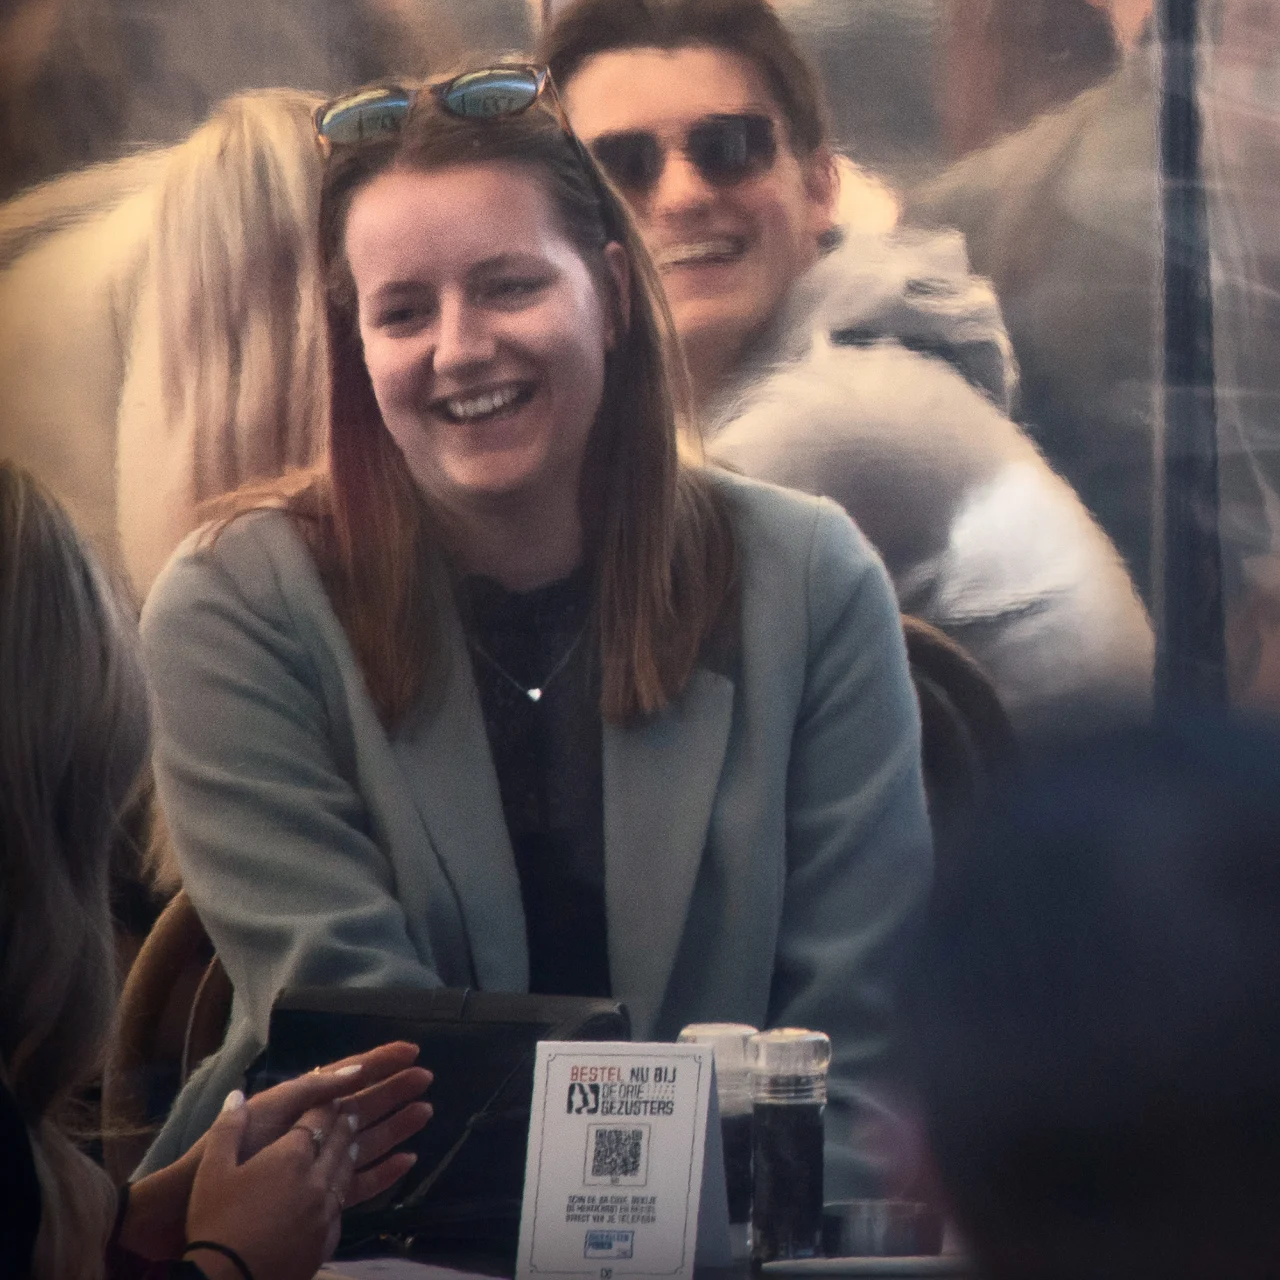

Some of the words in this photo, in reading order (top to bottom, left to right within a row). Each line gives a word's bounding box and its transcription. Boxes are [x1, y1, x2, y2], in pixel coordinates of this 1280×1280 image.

[571, 1065, 624, 1082] BESTEL
[630, 1066, 649, 1083] NU
[654, 1066, 677, 1083] BIJ
[601, 1100, 675, 1116] GEZUSTERS
